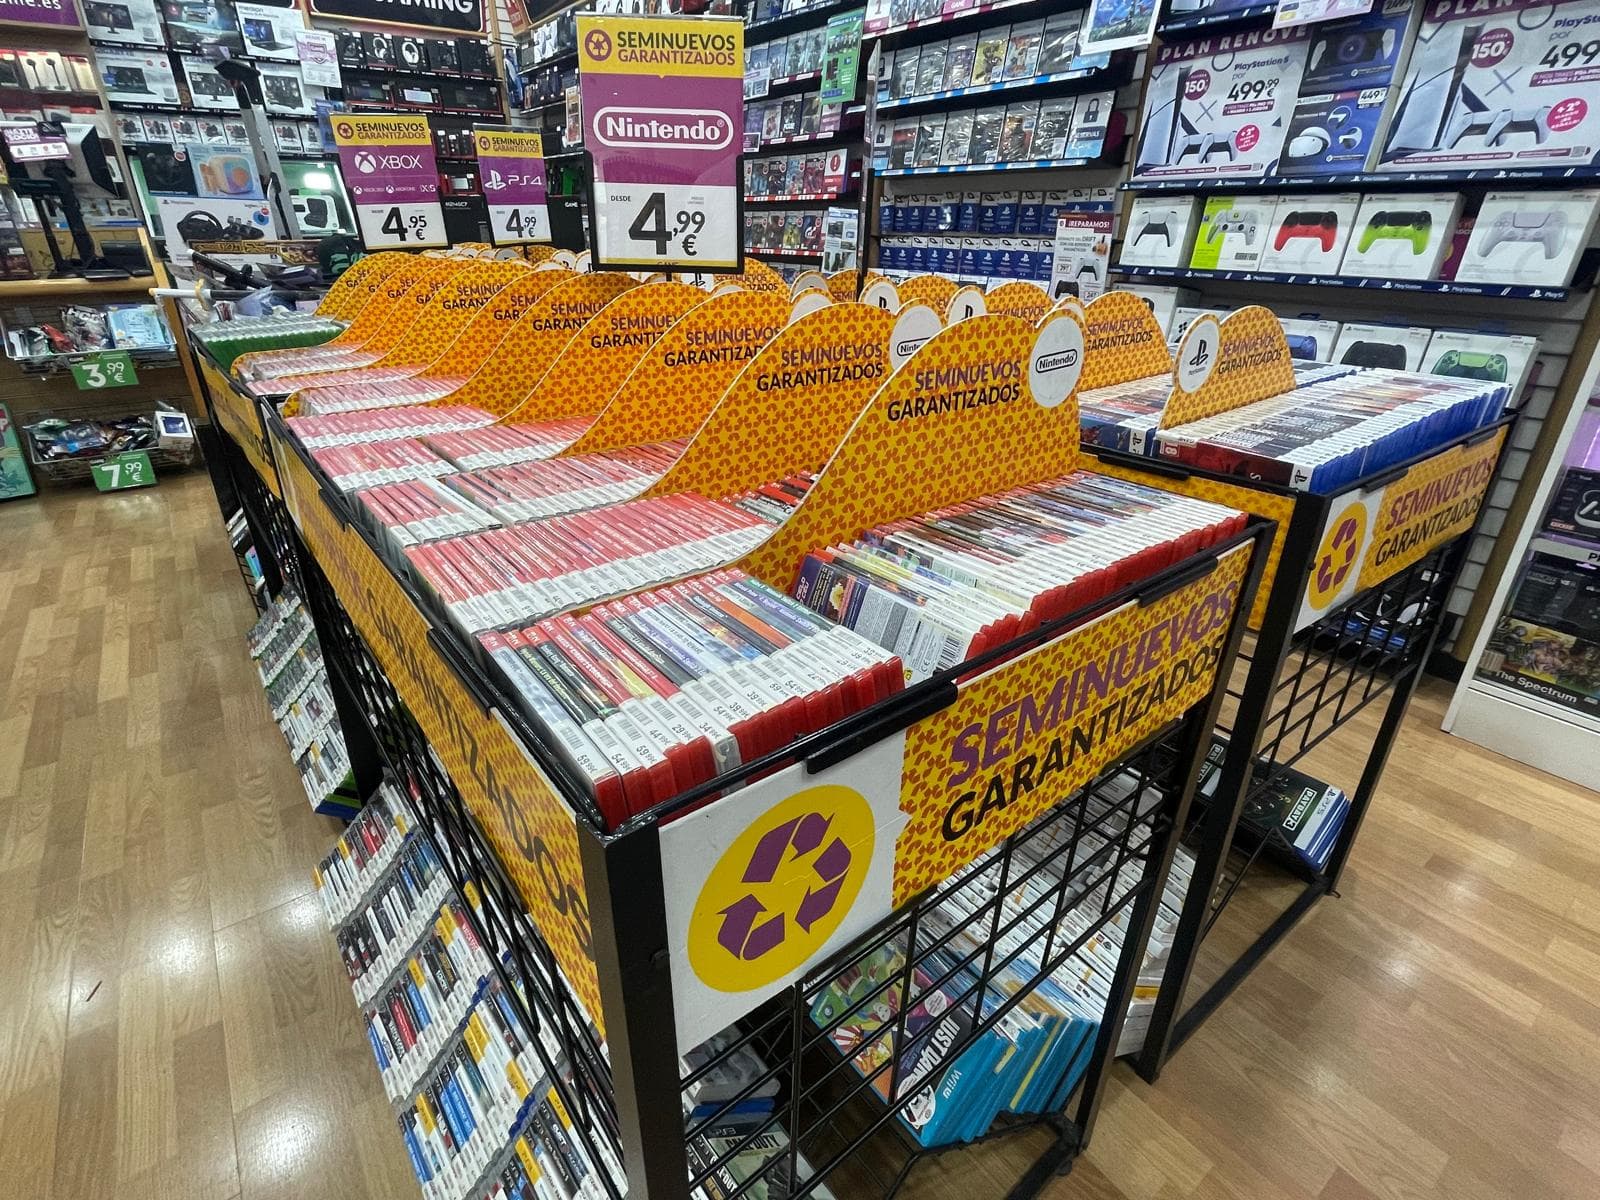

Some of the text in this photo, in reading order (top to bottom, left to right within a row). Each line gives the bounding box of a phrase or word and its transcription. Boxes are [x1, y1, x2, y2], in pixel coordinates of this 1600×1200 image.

[617, 31, 735, 52] SEMINUEVOS
[1161, 26, 1307, 61] PLAN RENOVE
[617, 49, 735, 66] GARANTIZADOS
[1234, 58, 1281, 71] PlayStation
[1232, 72, 1246, 81] por
[356, 122, 425, 132] SEMINUEVOS
[357, 131, 426, 140] GARANTIZADOS
[606, 117, 721, 141] Nintendo
[492, 137, 539, 147] SEMINUEVOS
[379, 154, 423, 169] XBOX
[507, 174, 542, 186] PS4
[610, 194, 631, 203] DESDE
[416, 228, 425, 241] €
[682, 233, 697, 257] €
[780, 343, 883, 368] SEMINUEVOS
[1223, 335, 1276, 357] SEMINUEVOS
[1038, 354, 1074, 370] Nintendo
[1218, 347, 1283, 375] GARANTIZADOS
[114, 372, 125, 383] €
[756, 362, 883, 392] GARANTIZADOS
[915, 359, 1021, 392] SEMINUEVOS
[887, 384, 1020, 421] GARANTIZADOS
[132, 472, 143, 482] €
[1385, 453, 1497, 532] SEMINUEVOS
[1375, 489, 1485, 567] GARANTIZADOS
[947, 580, 1238, 787] SEMINUEVOS
[1495, 669, 1578, 704] The Spectrum
[941, 634, 1225, 842] GARANTIZADOS
[1291, 790, 1314, 821] PAYDAY
[934, 1014, 961, 1058] JUST
